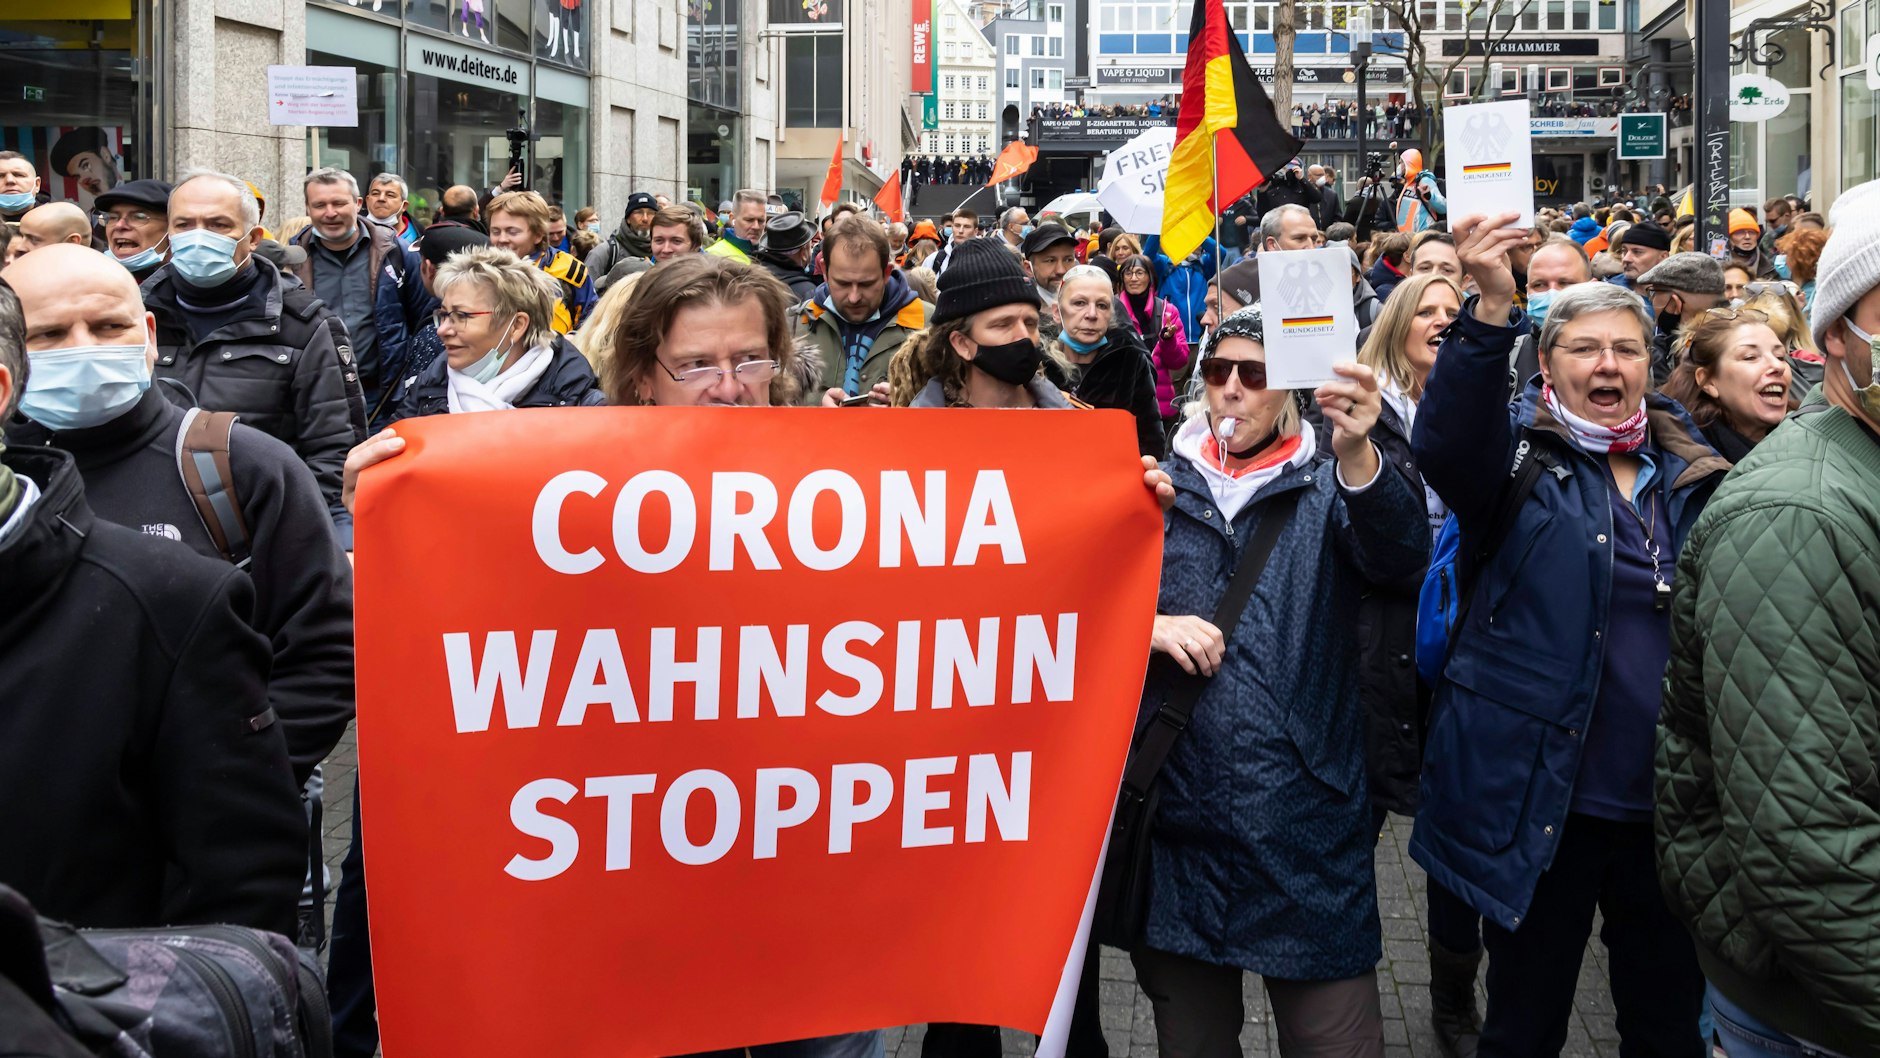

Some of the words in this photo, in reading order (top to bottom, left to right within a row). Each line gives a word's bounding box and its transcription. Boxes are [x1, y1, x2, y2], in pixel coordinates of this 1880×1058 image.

[913, 23, 926, 64] REWE
[422, 49, 517, 84] www.deiters.de
[1102, 69, 1124, 77] VAPE
[1125, 69, 1134, 77] &
[1134, 69, 1165, 78] LIQUID
[1764, 97, 1785, 105] Erde
[1086, 120, 1137, 128] E-ZIGARETTEN,
[1463, 171, 1512, 181] GRUNDGESETZ
[1535, 175, 1559, 196] by
[1282, 325, 1334, 335] GRUNDGESETZ
[141, 523, 164, 531] THE
[532, 470, 1026, 574] CORONA
[443, 613, 1078, 733] WAHNSINN
[504, 752, 1032, 880] STOPPEN
